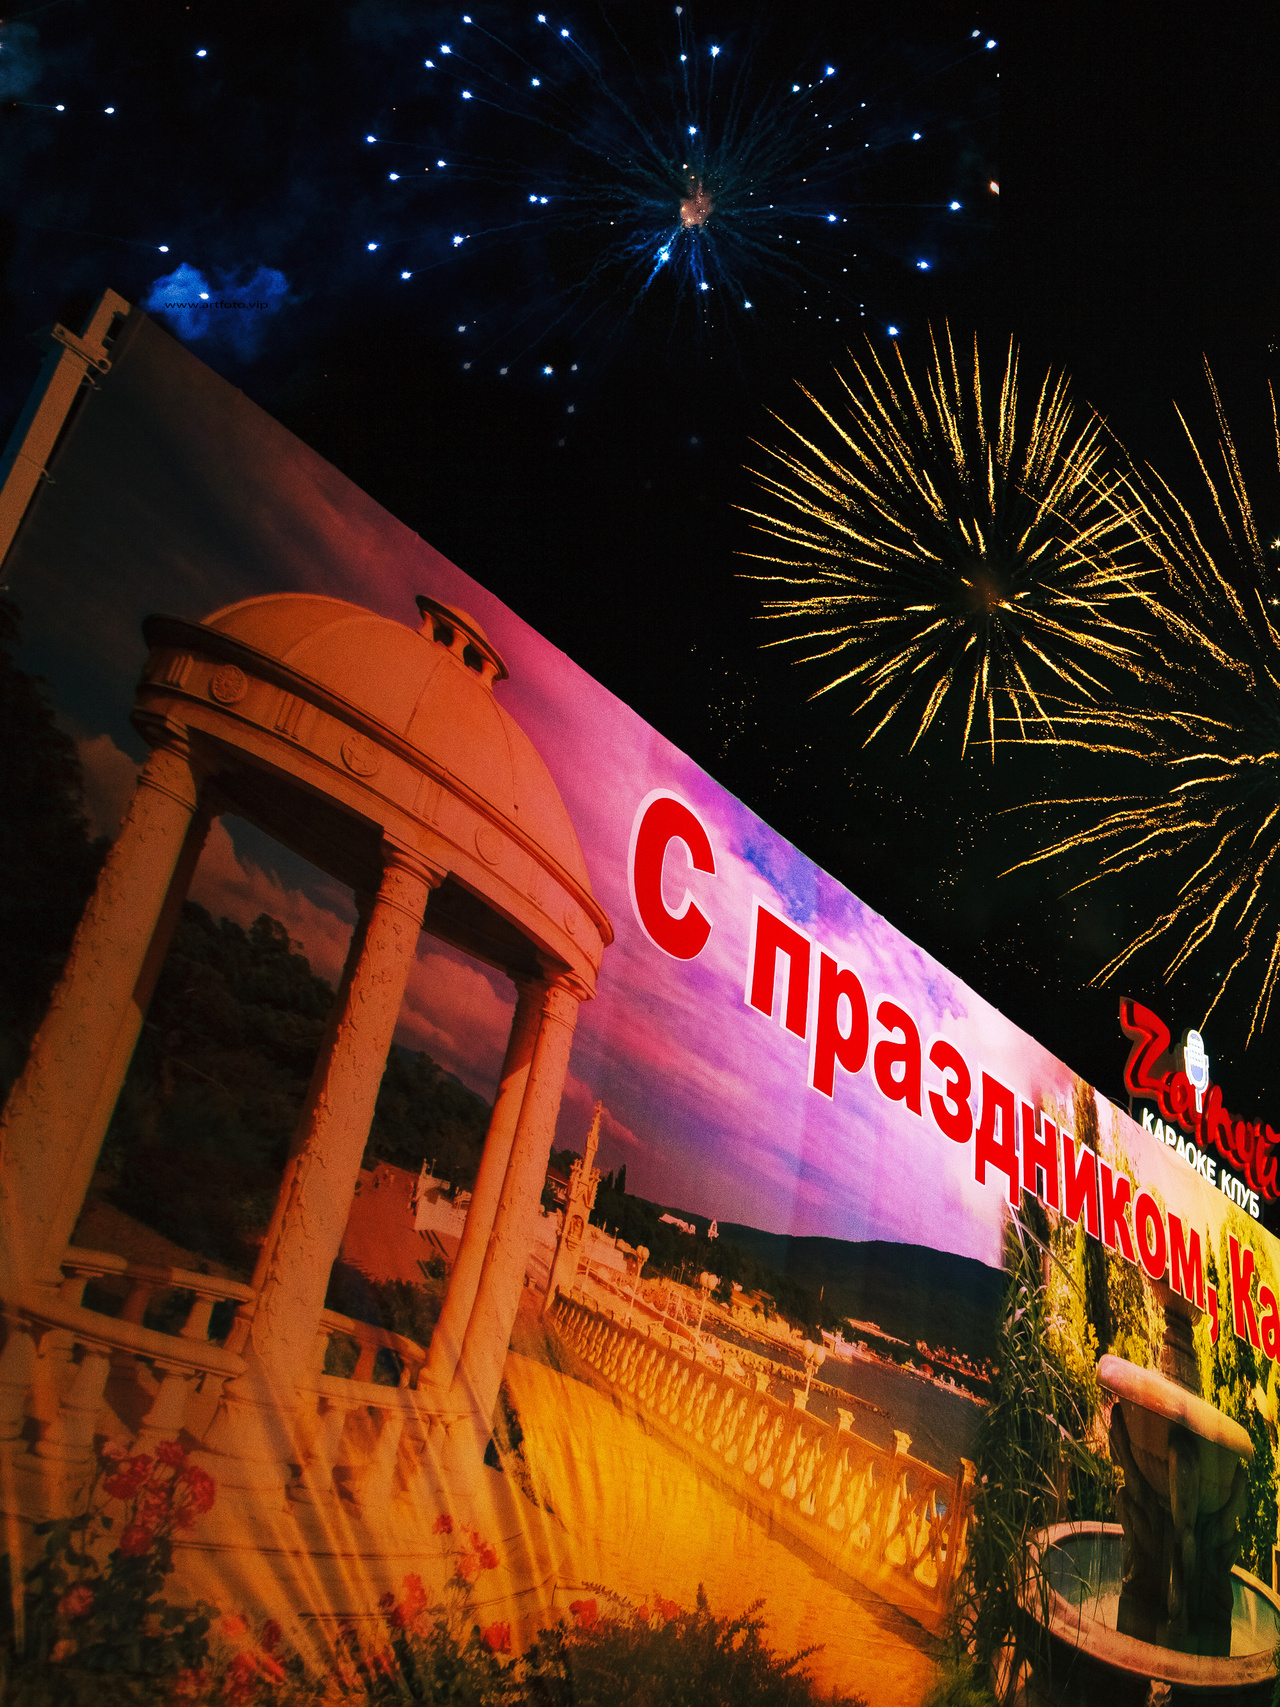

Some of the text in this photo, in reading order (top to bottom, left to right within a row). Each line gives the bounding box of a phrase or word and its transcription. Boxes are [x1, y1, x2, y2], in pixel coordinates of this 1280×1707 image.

[628, 788, 716, 961] С
[744, 895, 1218, 1345] праздником,
[1142, 1107, 1260, 1219] КАРАОКЕ КЛУБ
